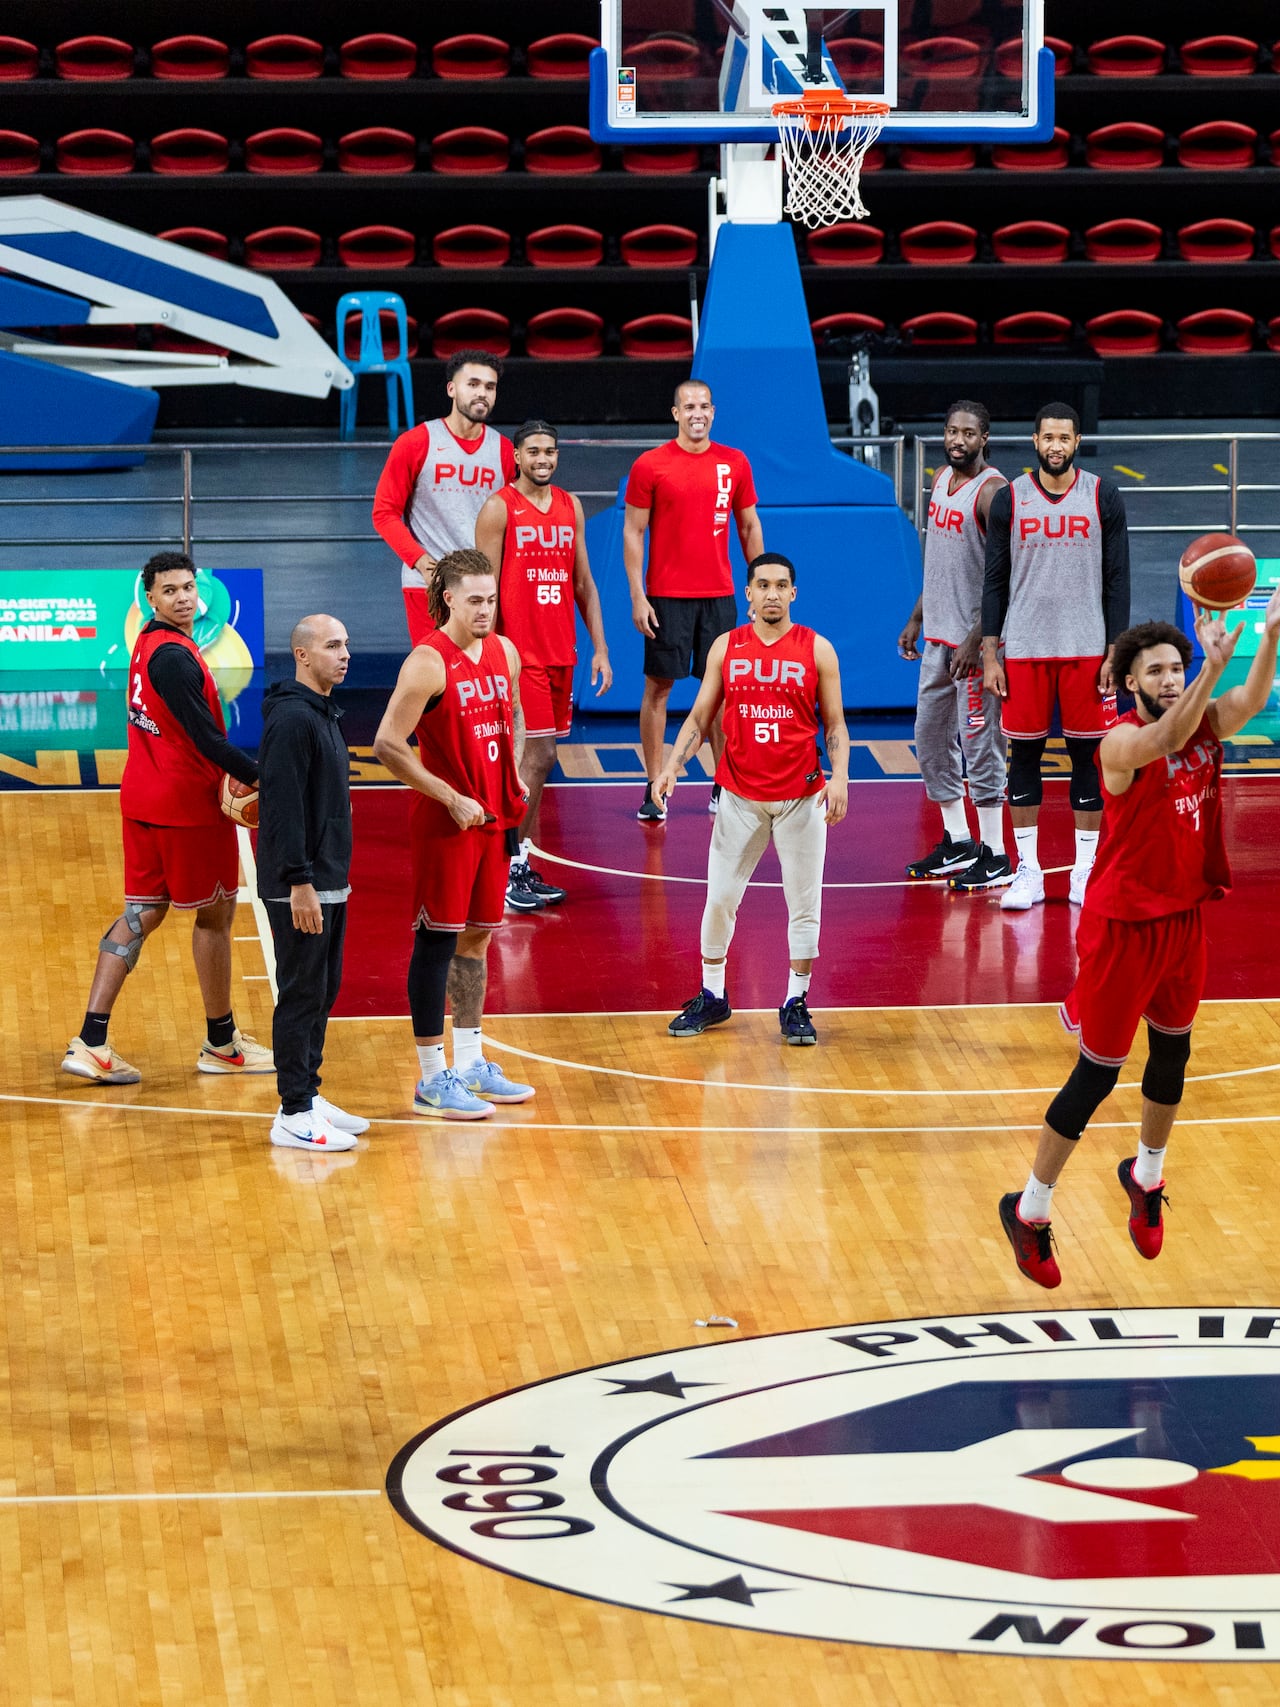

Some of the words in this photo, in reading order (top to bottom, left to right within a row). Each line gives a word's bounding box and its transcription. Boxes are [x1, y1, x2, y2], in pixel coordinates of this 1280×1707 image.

[434, 463, 496, 490] PUR
[716, 463, 732, 509] PUR
[928, 501, 965, 534] PUR
[1019, 515, 1091, 541] PUR
[515, 525, 575, 549] PUR
[537, 568, 569, 582] Mobile
[0, 598, 97, 609] BASKETBALL
[536, 584, 562, 605] 55
[19, 610, 52, 622] CUP
[55, 610, 97, 622] 2023
[729, 658, 806, 688] PUR
[456, 674, 510, 707] PUR
[750, 704, 794, 719] Mobile
[754, 722, 780, 744] 51
[487, 740, 499, 762] 0
[1185, 784, 1217, 812] Mile
[1192, 808, 1201, 832] 1
[435, 1444, 597, 1541] 1990
